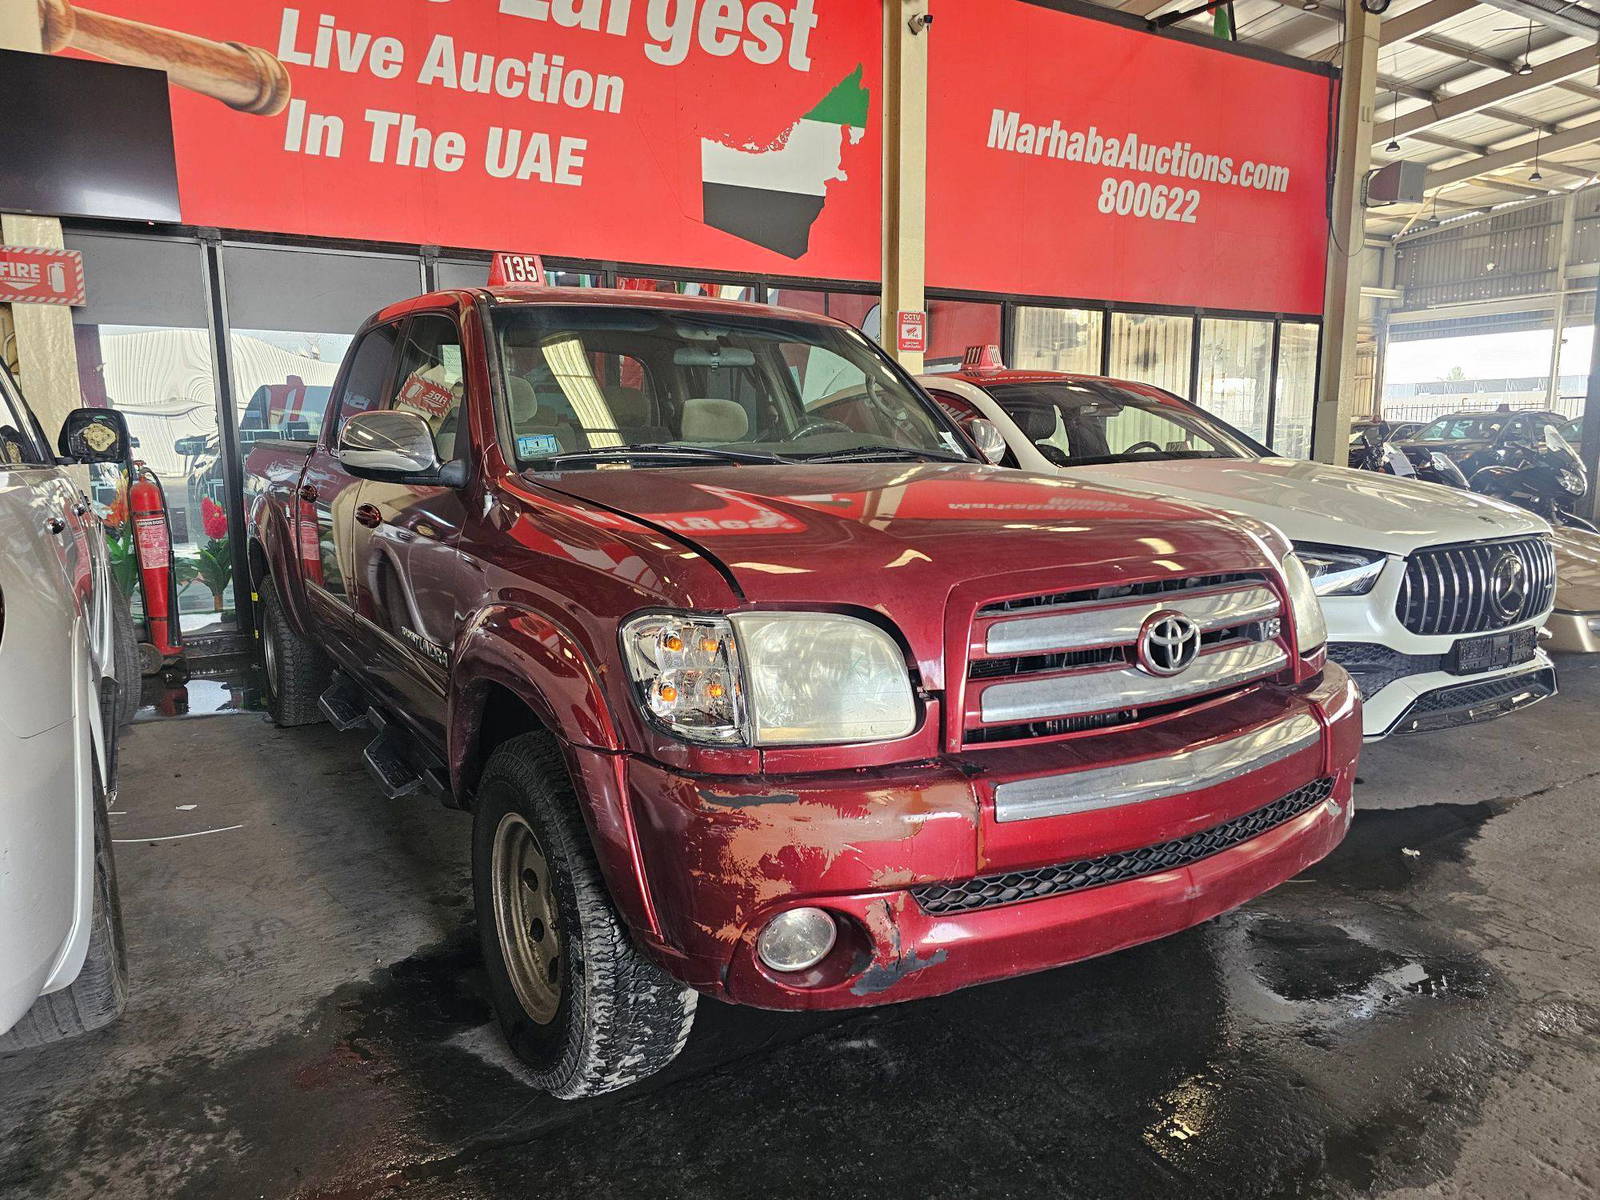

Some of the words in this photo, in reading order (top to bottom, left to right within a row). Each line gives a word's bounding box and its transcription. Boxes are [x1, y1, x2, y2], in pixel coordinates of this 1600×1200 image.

[499, 0, 819, 72] rgest
[274, 8, 405, 79] Live
[417, 35, 625, 114] Auction
[285, 98, 344, 159] In
[365, 109, 465, 173] The
[485, 127, 588, 187] UAE
[987, 108, 1289, 193] MarhabaAuctions.com
[1098, 178, 1200, 224] 800622
[0, 261, 41, 278] FIRE
[504, 256, 538, 282] 135
[903, 313, 921, 321] CCTV
[966, 346, 981, 363] 111
